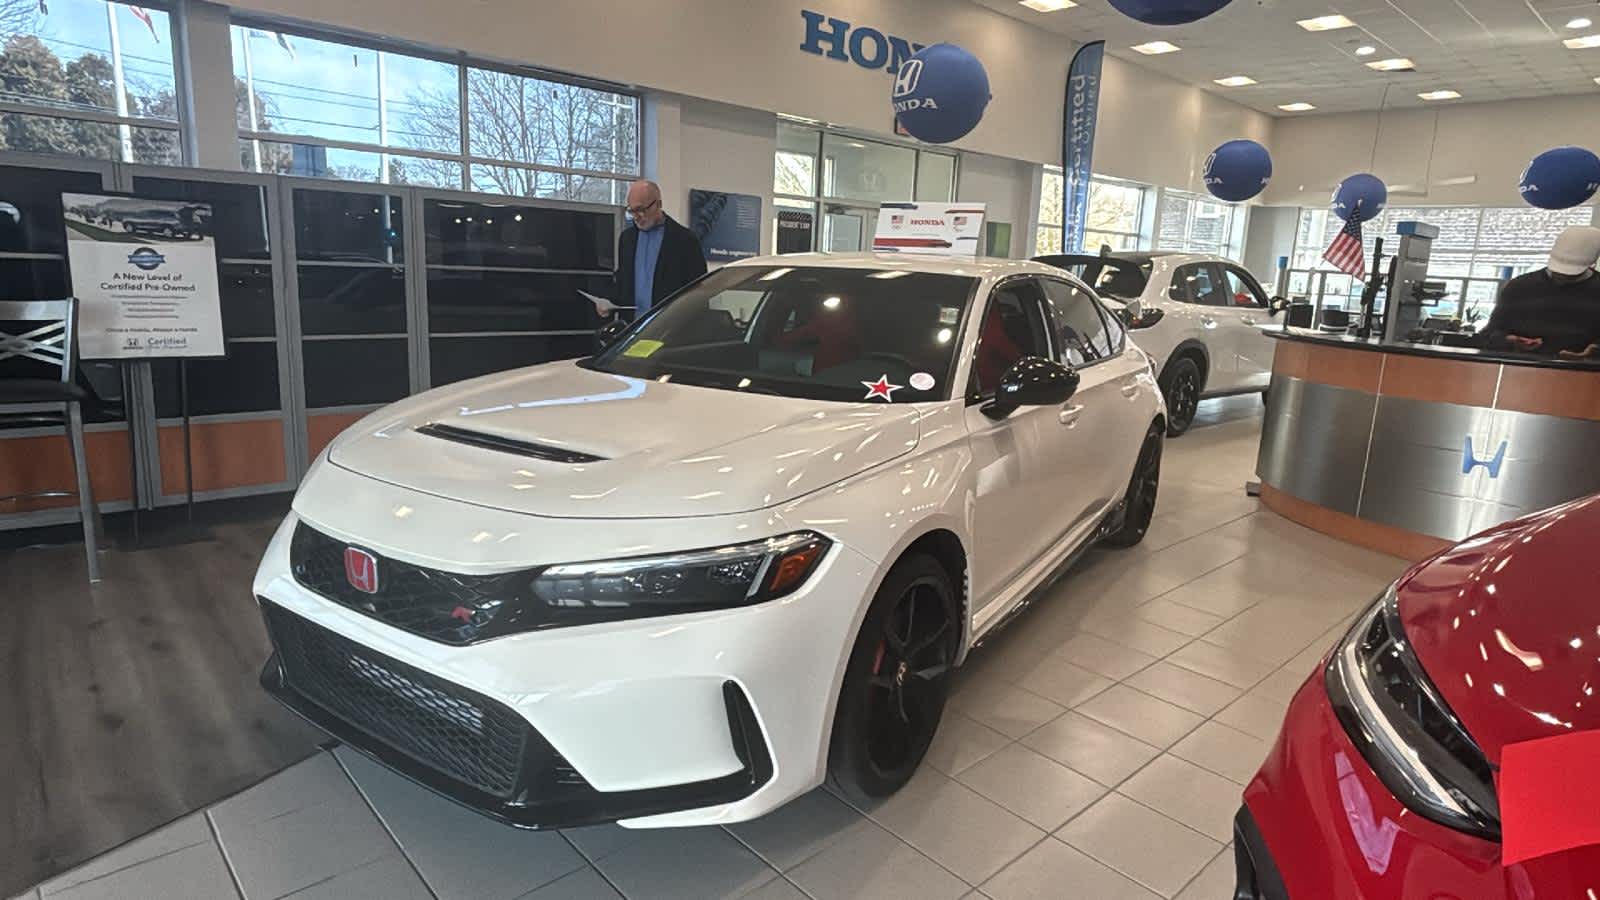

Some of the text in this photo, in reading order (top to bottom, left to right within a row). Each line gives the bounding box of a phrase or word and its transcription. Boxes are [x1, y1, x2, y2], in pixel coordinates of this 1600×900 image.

[799, 9, 922, 75] HON
[894, 98, 938, 113] NDA
[911, 218, 945, 226] HONDA
[113, 273, 182, 282] A New Level of
[100, 282, 196, 292] Certified Pre-Owned
[147, 337, 187, 346] Certified
